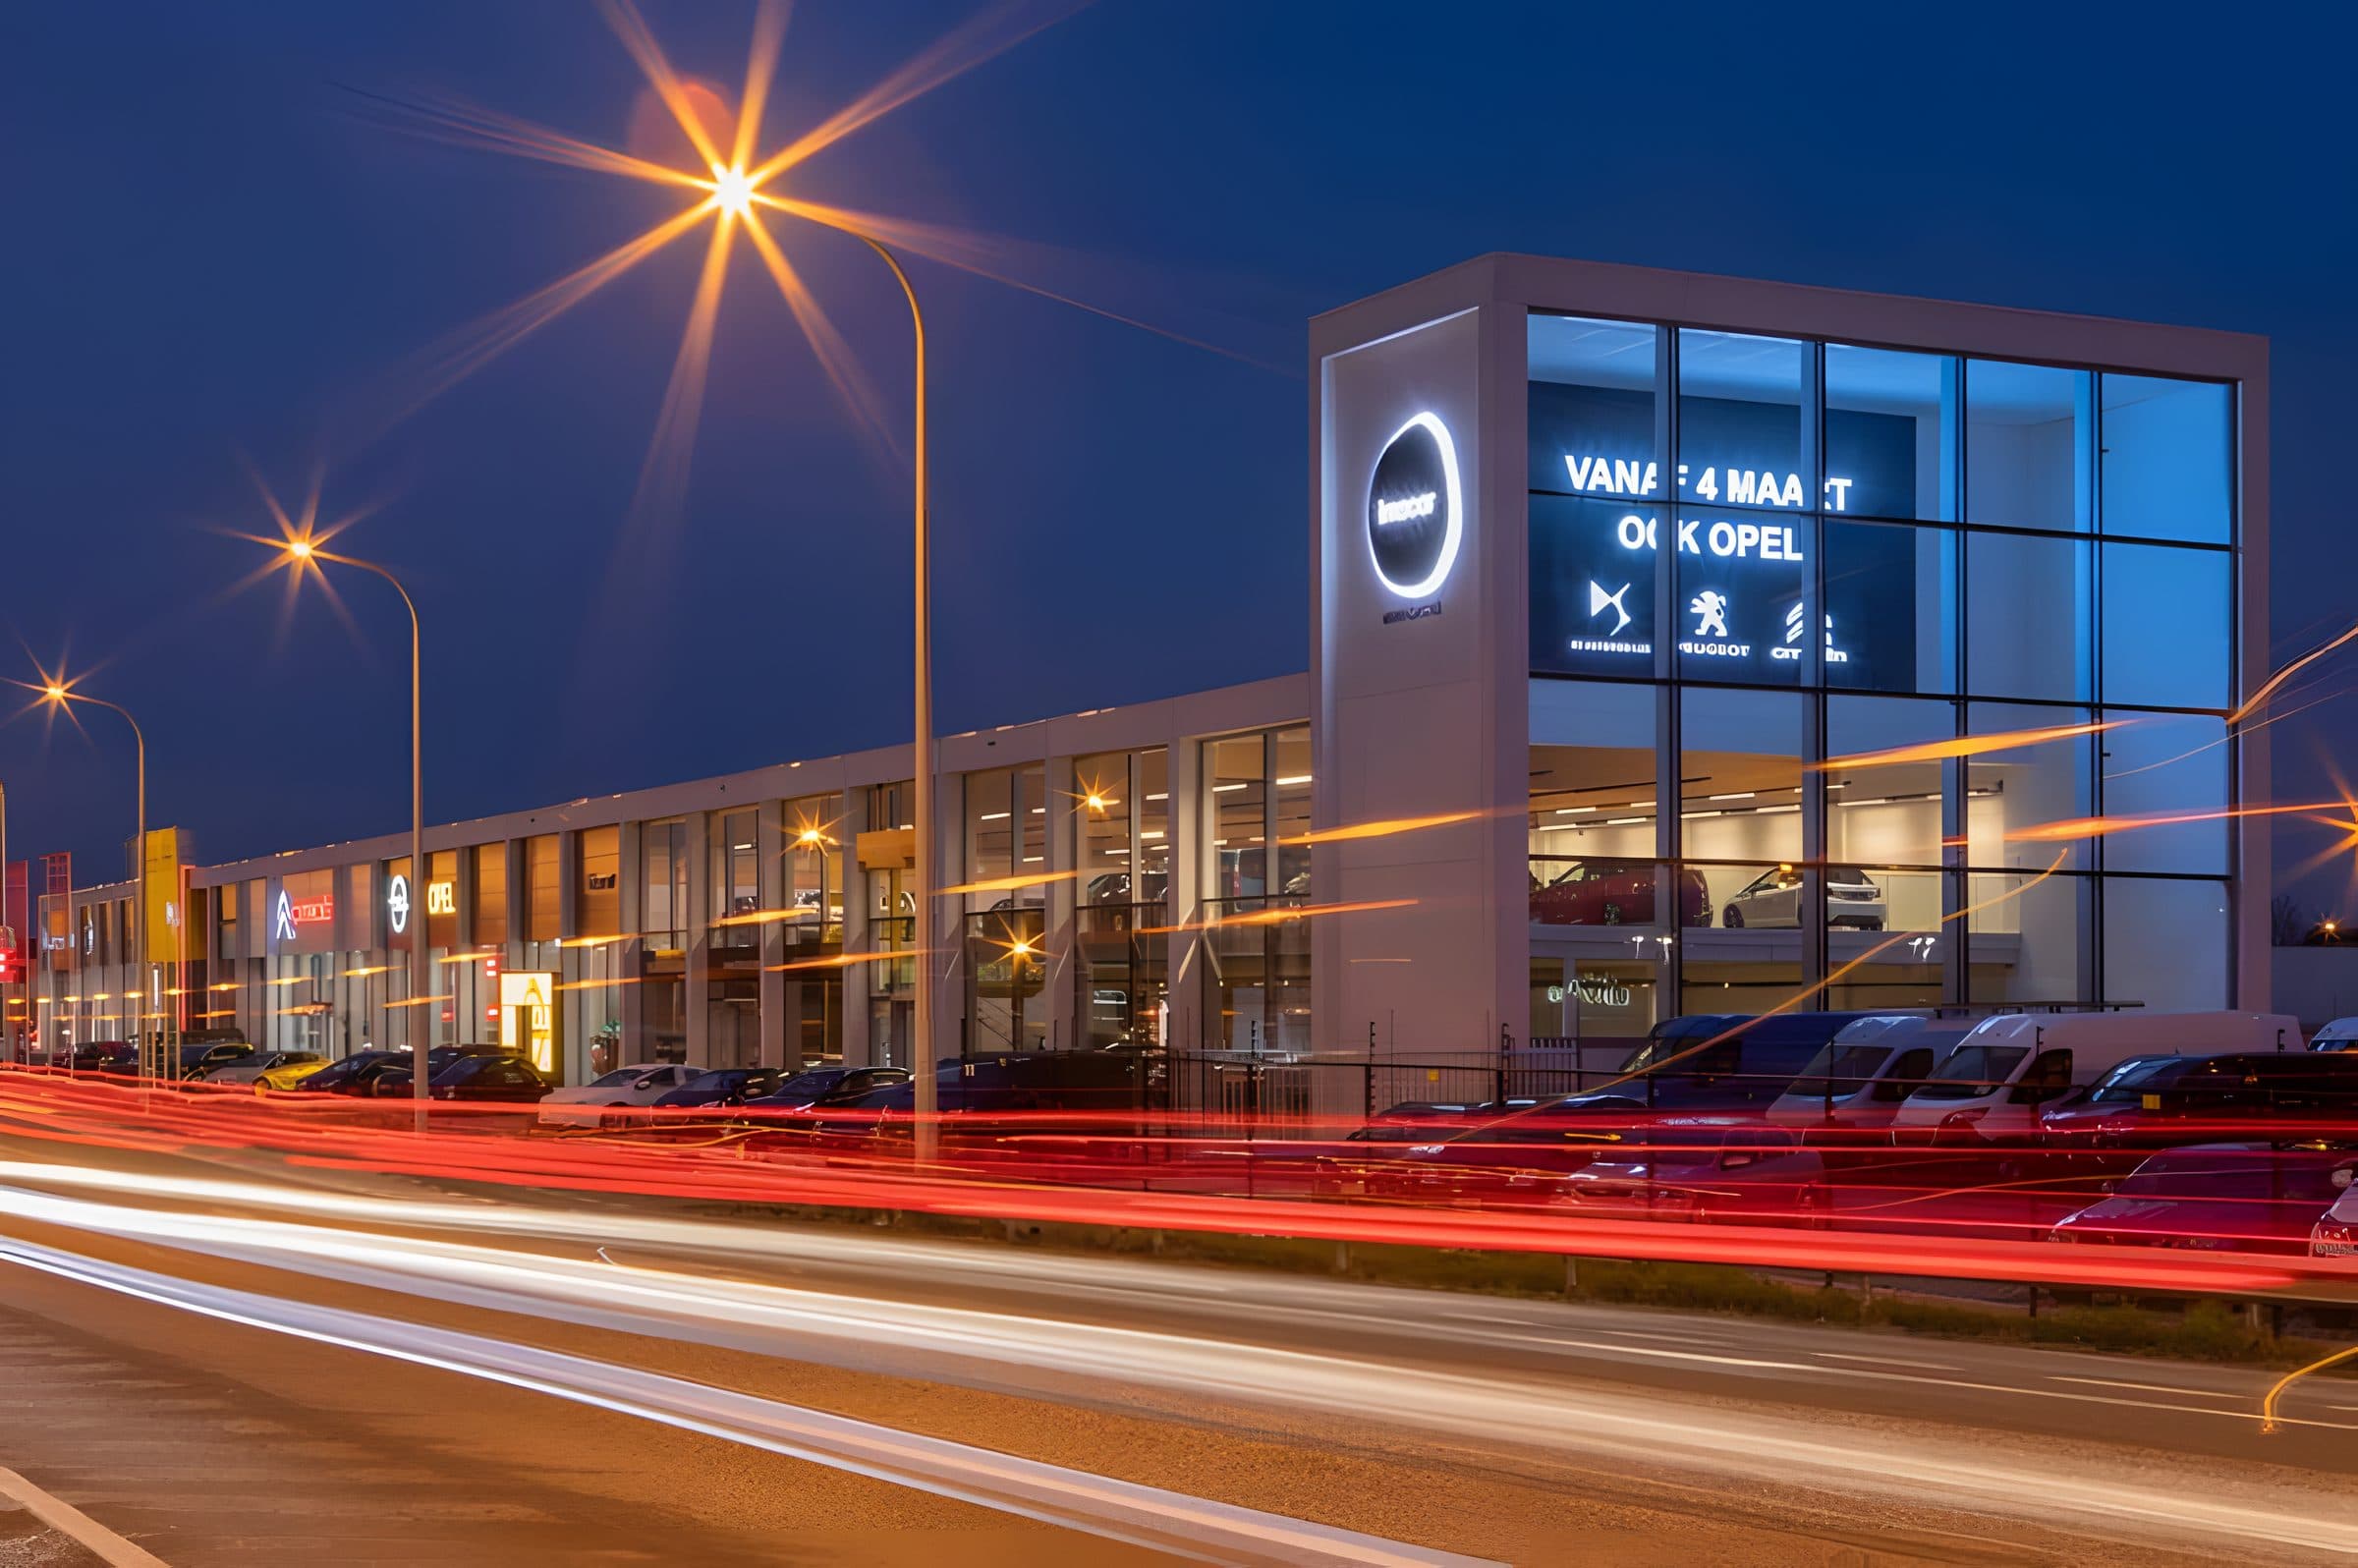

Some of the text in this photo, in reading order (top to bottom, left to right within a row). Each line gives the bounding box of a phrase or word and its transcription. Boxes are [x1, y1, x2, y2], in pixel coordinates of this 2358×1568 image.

[1696, 466, 1719, 501] 4
[1709, 522, 1804, 561] OPEL
[428, 882, 456, 915] OPEL
